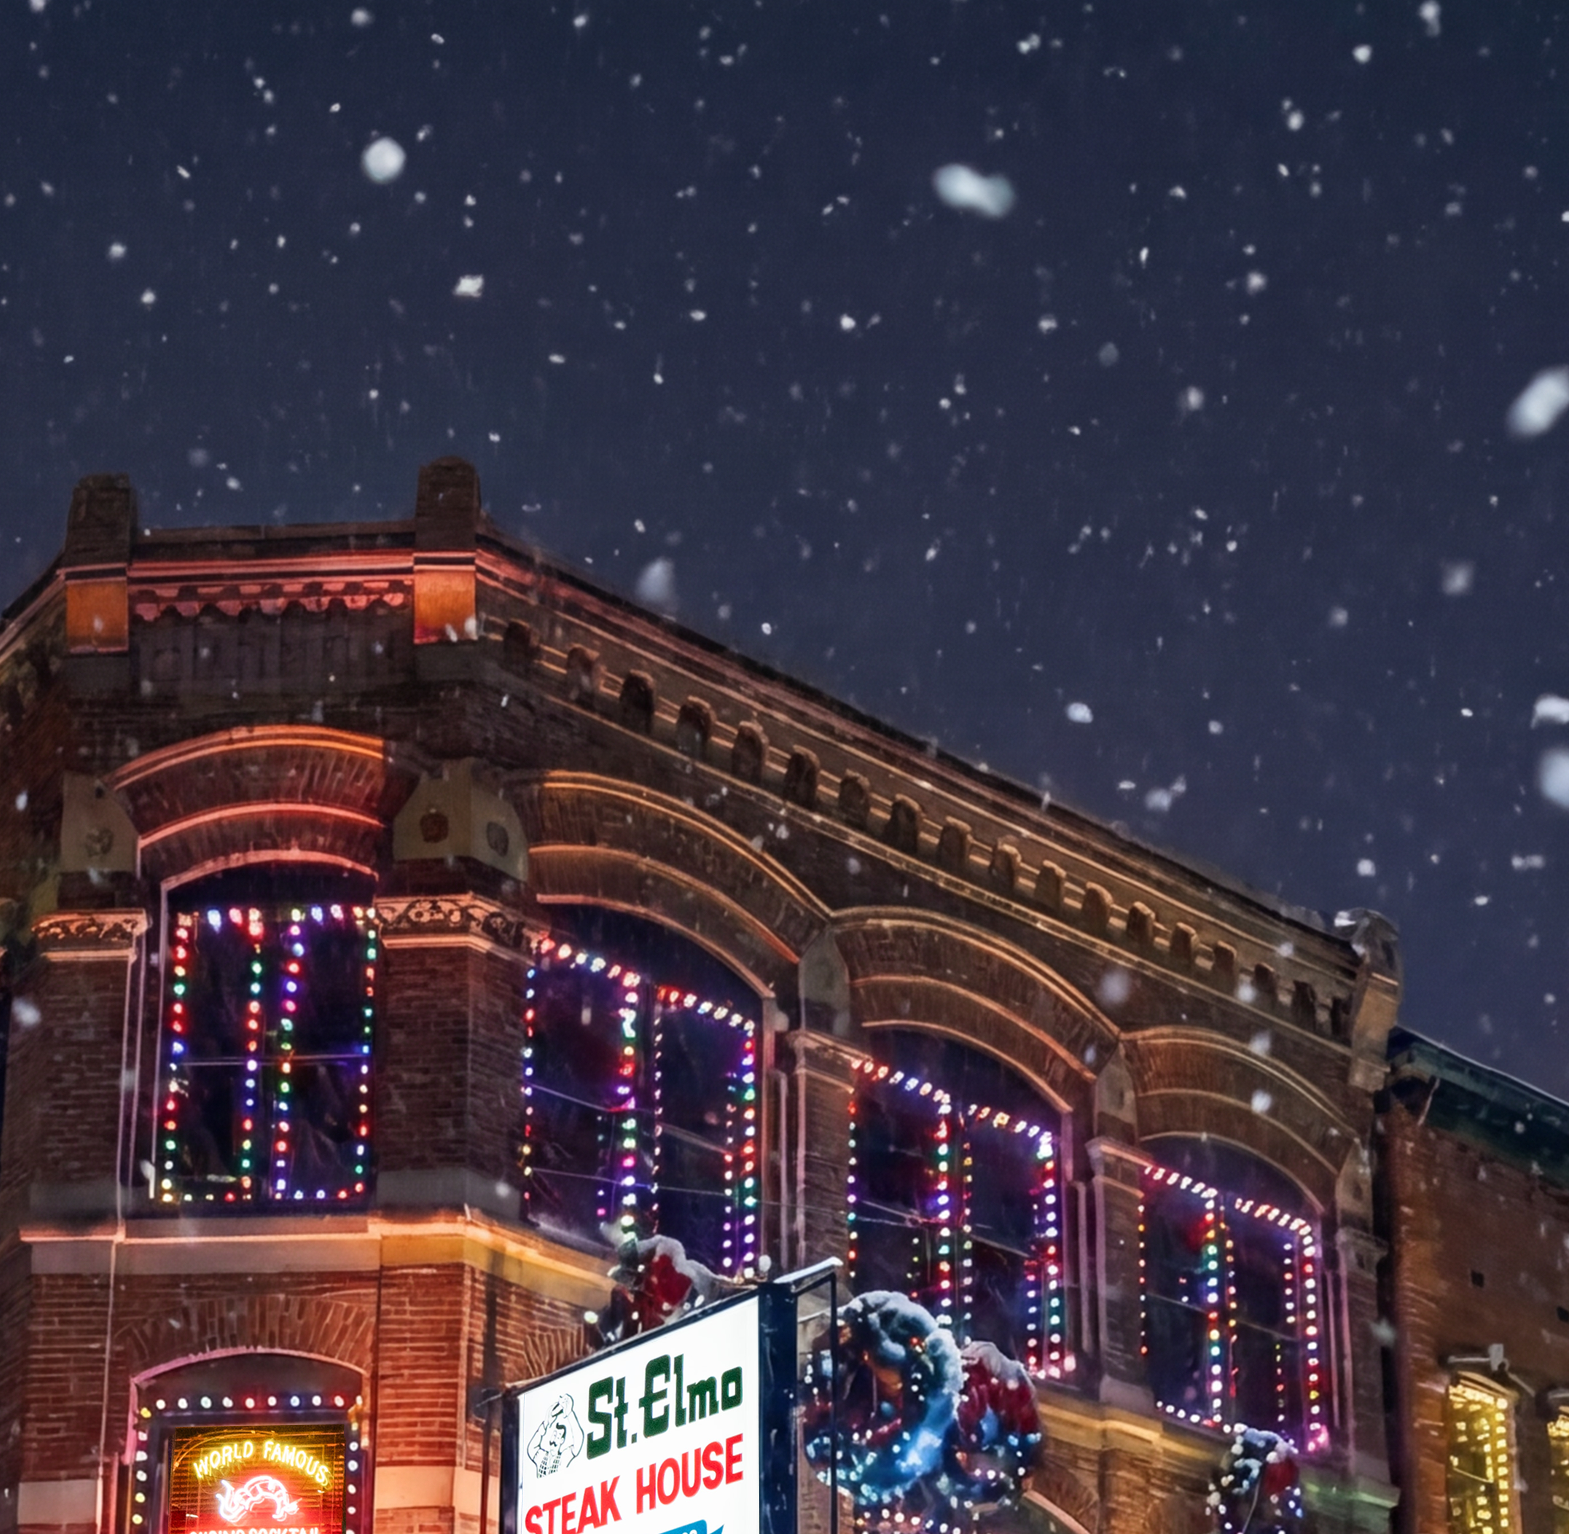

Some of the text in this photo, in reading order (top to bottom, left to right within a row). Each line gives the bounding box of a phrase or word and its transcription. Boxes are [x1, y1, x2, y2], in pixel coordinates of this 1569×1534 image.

[586, 1354, 743, 1460] St. Elmo
[193, 1440, 329, 1485] WORLD FAMOUS
[636, 1433, 743, 1514] HOUSE
